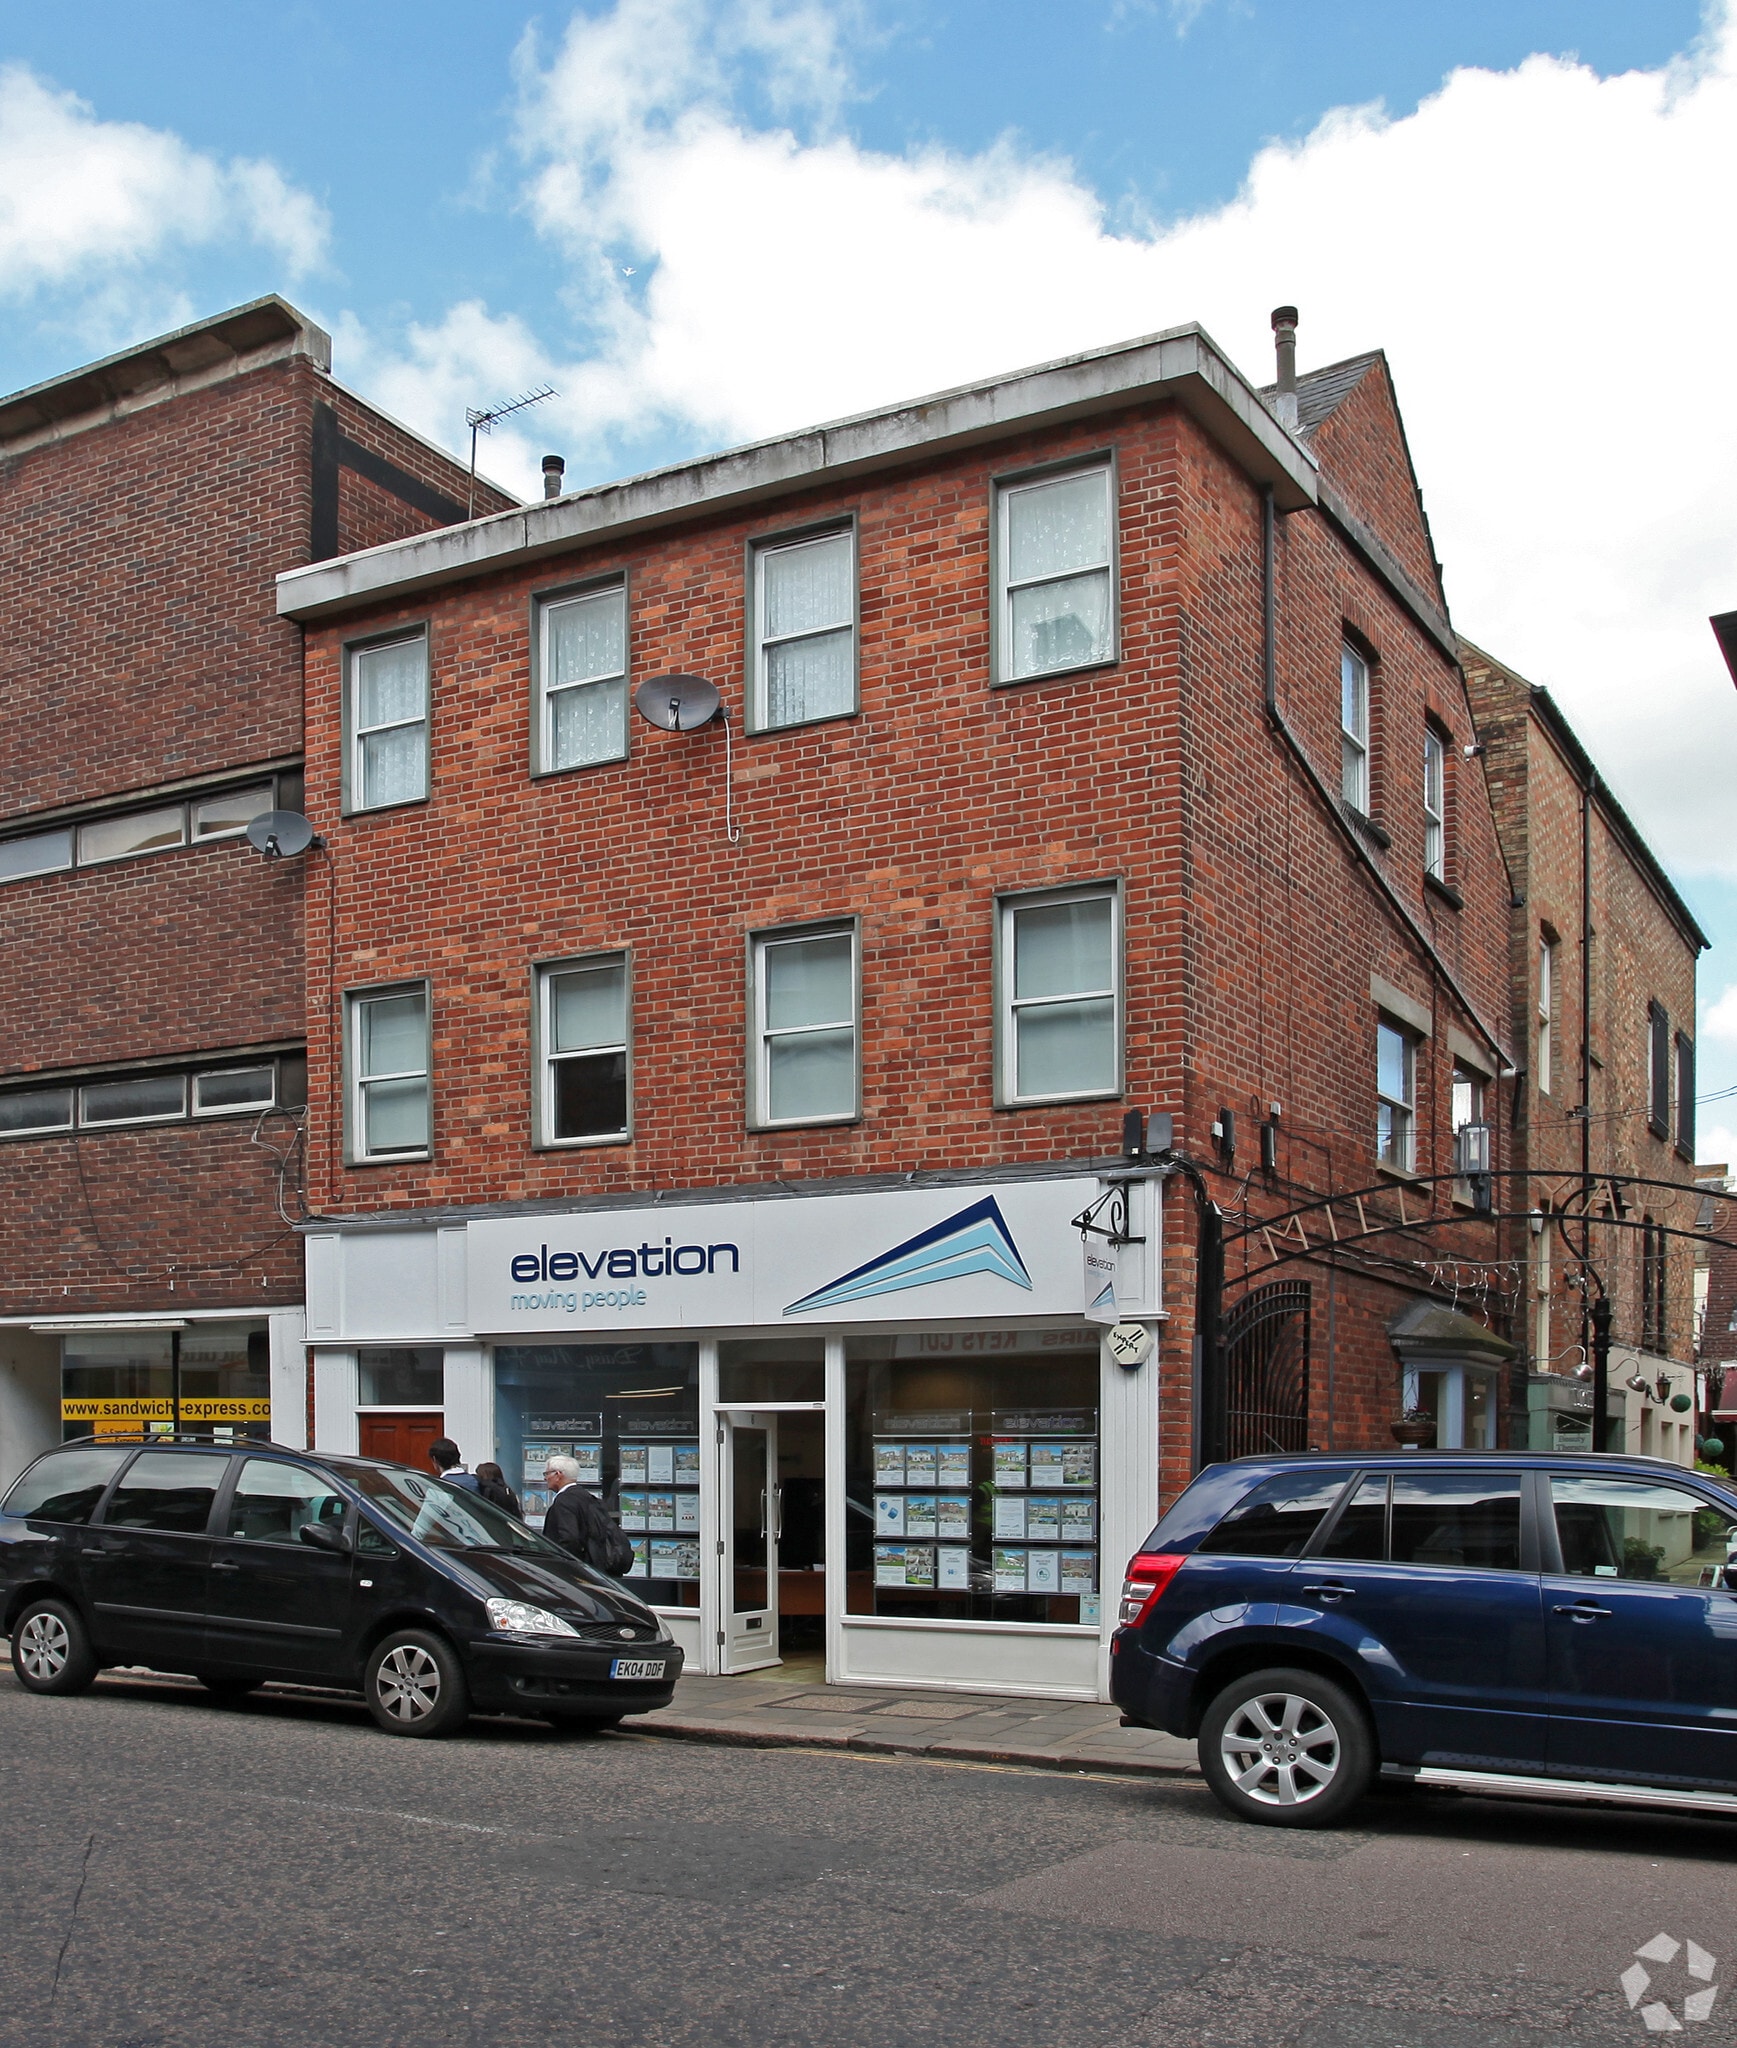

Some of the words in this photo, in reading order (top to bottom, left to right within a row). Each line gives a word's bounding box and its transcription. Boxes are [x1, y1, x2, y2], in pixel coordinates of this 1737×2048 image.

[1261, 1184, 1429, 1261] MILL
[1537, 1175, 1733, 1237] YARD
[510, 1236, 740, 1284] elevation
[1086, 1253, 1116, 1272] elevation
[510, 1287, 578, 1313] moving
[582, 1283, 648, 1312] people
[1112, 1330, 1140, 1354] EXPERT
[530, 1417, 593, 1431] elevation
[627, 1417, 694, 1431] elevation
[883, 1415, 961, 1430] elevation
[1002, 1414, 1086, 1429] elevation
[616, 1661, 643, 1676] EK04
[645, 1662, 664, 1677] DDF
